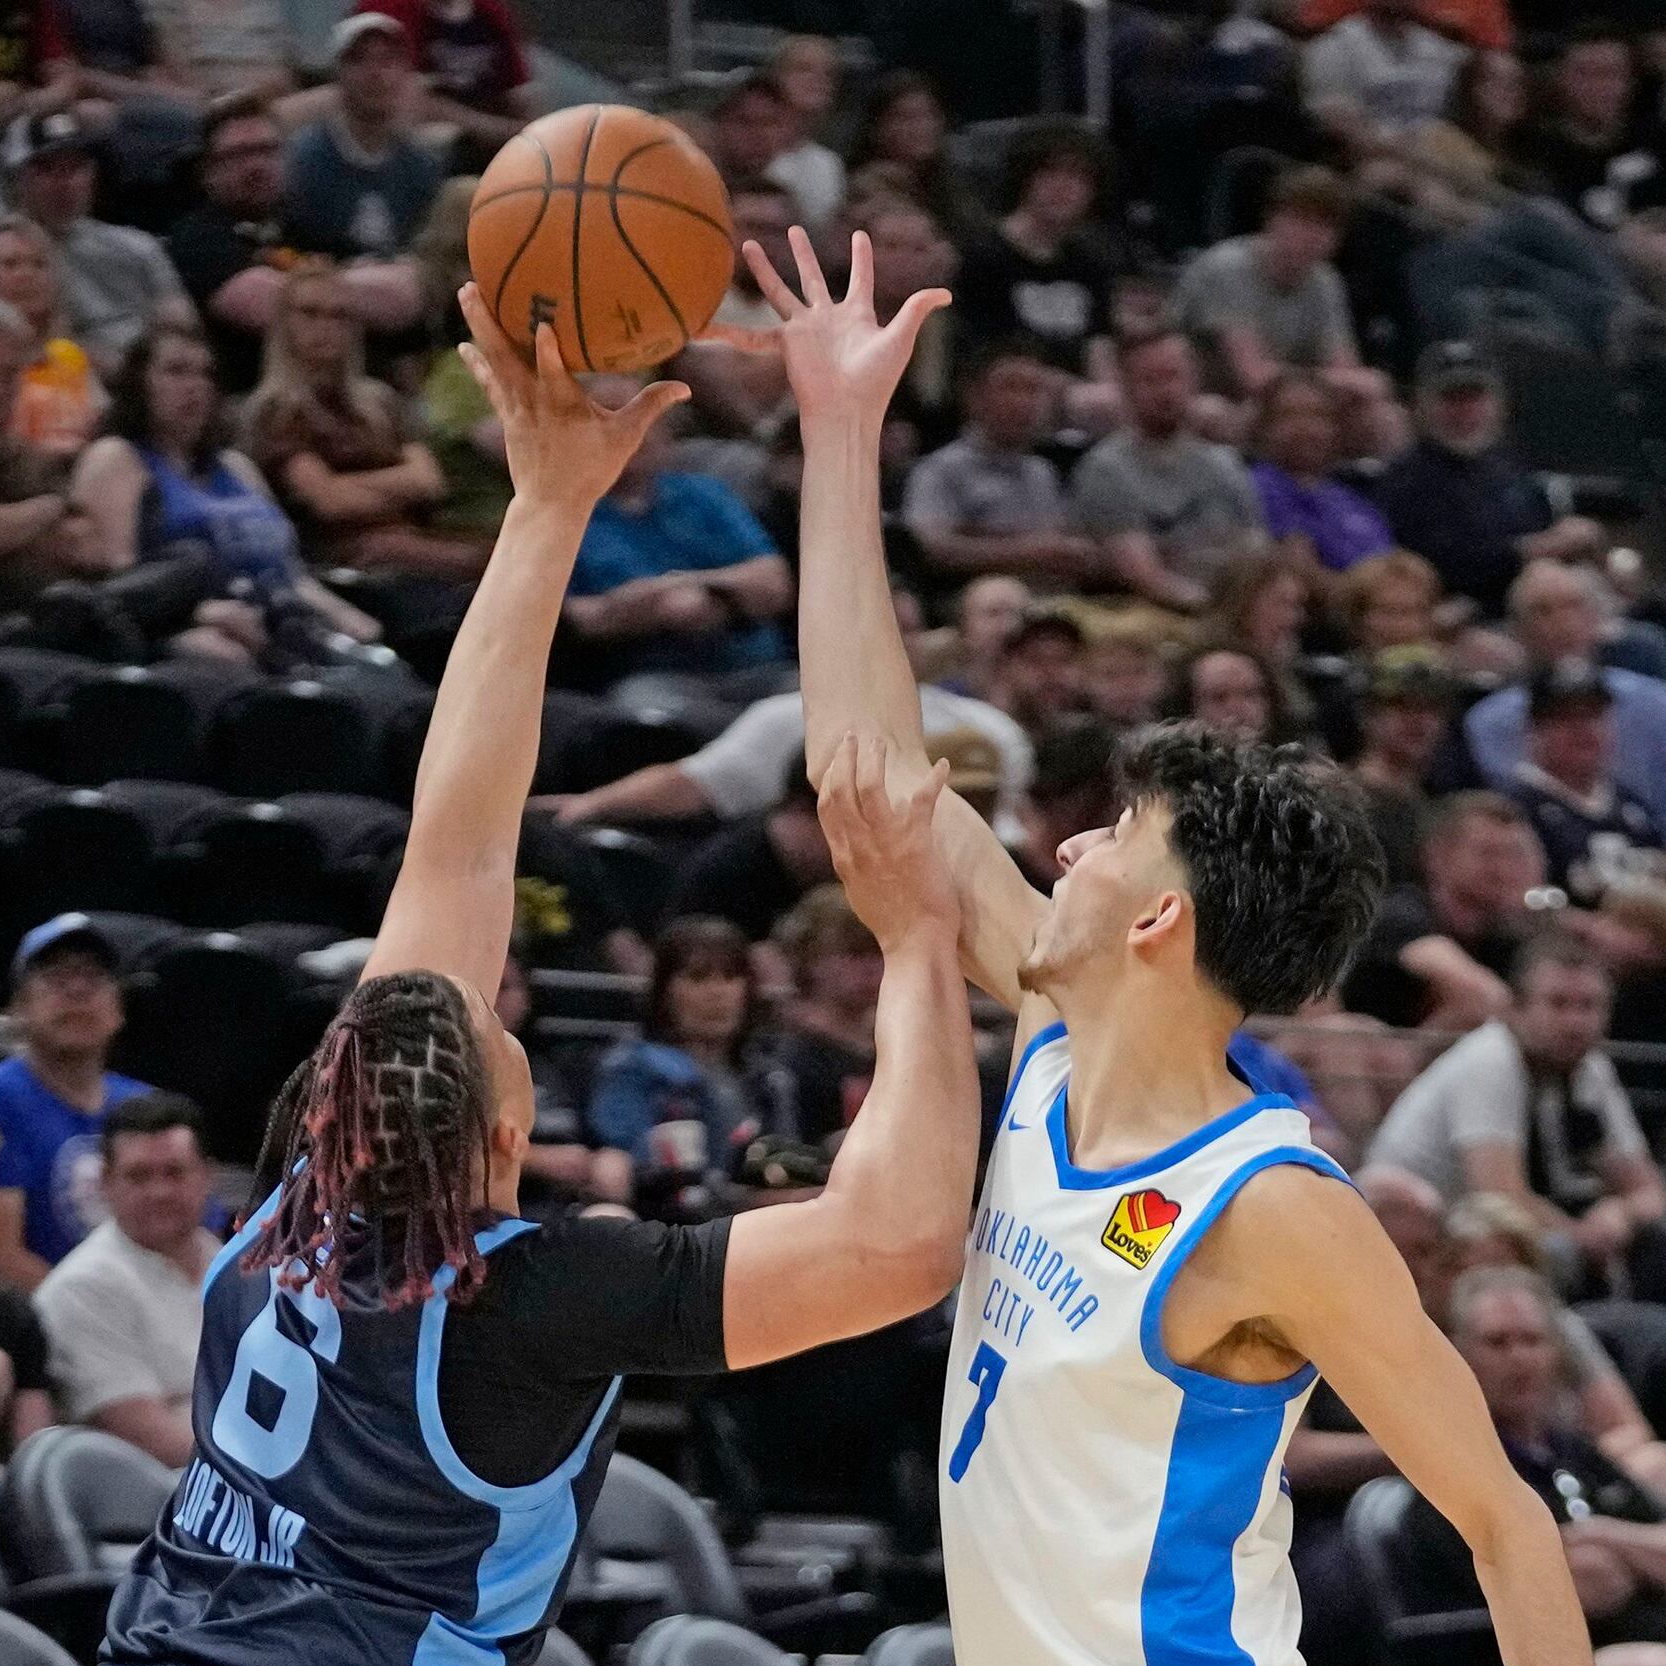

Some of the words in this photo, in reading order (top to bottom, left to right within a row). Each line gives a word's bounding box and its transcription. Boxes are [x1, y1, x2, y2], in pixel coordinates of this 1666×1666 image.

[975, 1207, 1099, 1332] OKLAHOMA
[983, 1278, 1035, 1347] CITY
[212, 1257, 343, 1480] 6
[949, 1340, 1008, 1484] 7
[173, 1457, 256, 1561] LOFTON
